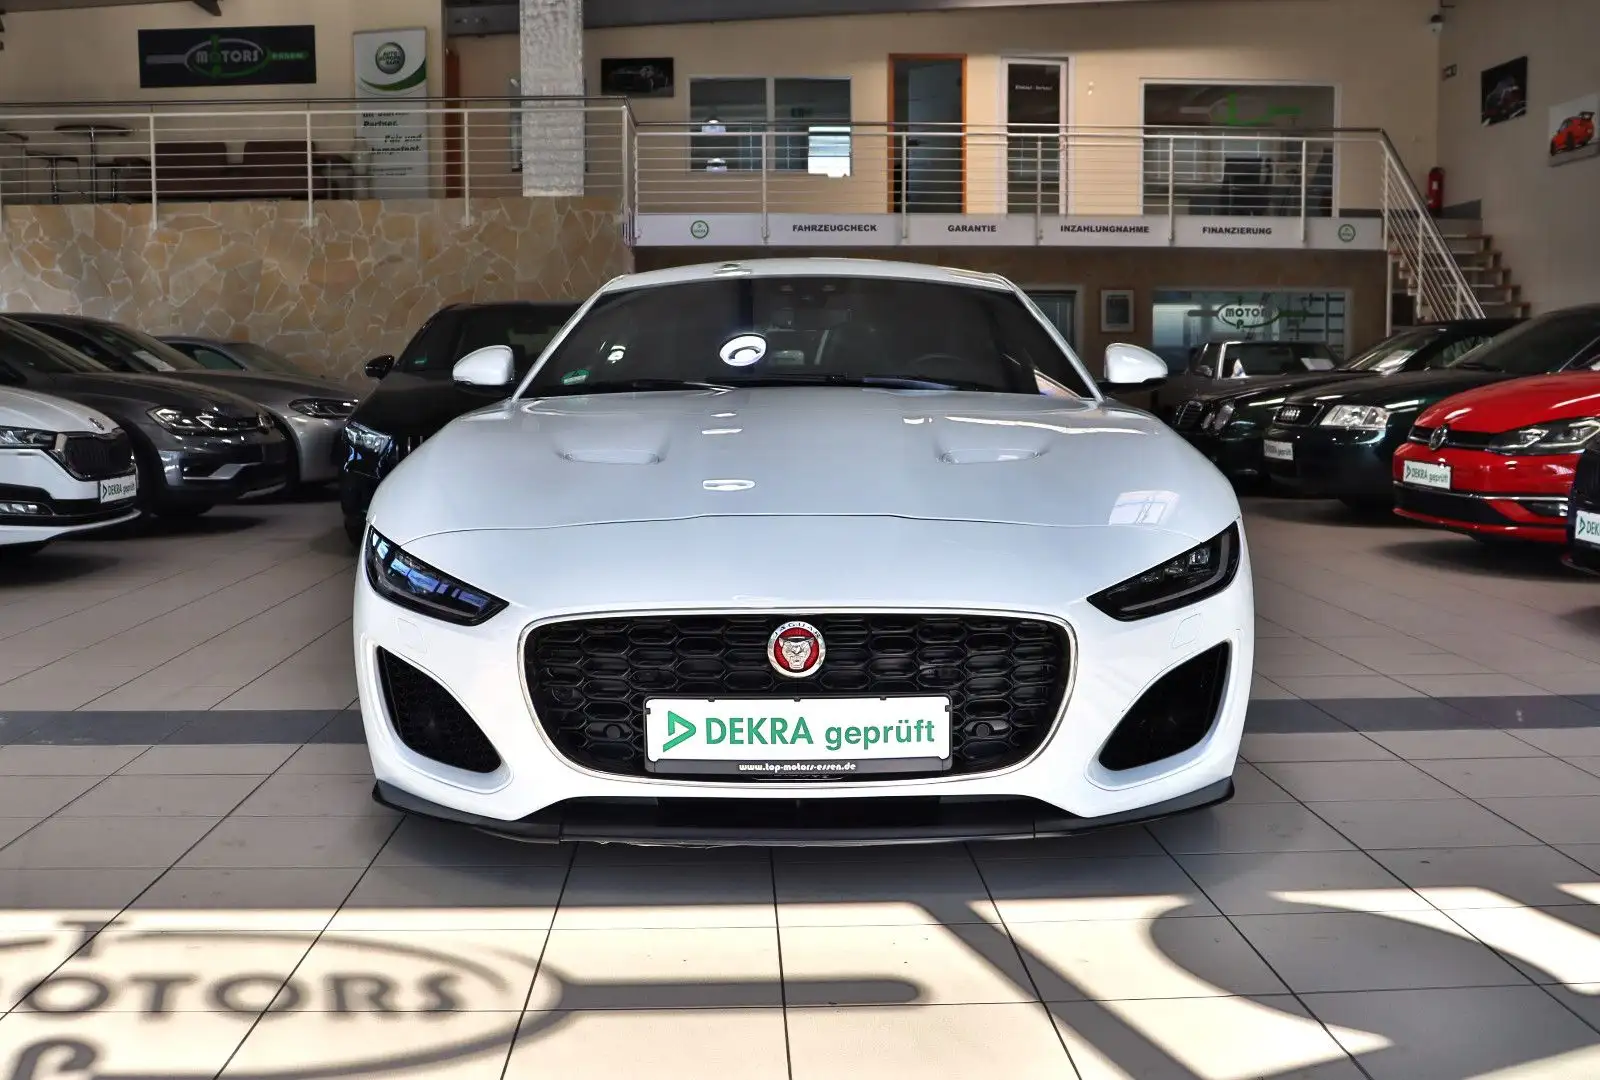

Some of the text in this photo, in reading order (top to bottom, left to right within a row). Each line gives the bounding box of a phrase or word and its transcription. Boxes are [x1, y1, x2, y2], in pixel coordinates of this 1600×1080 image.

[195, 49, 259, 64] MOTORS
[792, 224, 877, 233] FAHRZEUGCHECK
[947, 224, 998, 233] GARANTIE
[1060, 224, 1150, 234] INZAHLUNGNAHME
[1202, 226, 1272, 235] FINANZIERUNG
[1411, 467, 1428, 479] DEKRA
[773, 622, 822, 639] JAGUAR
[705, 717, 935, 751] DEKRA geprüft
[738, 762, 857, 773] www.top-motors-essen.de
